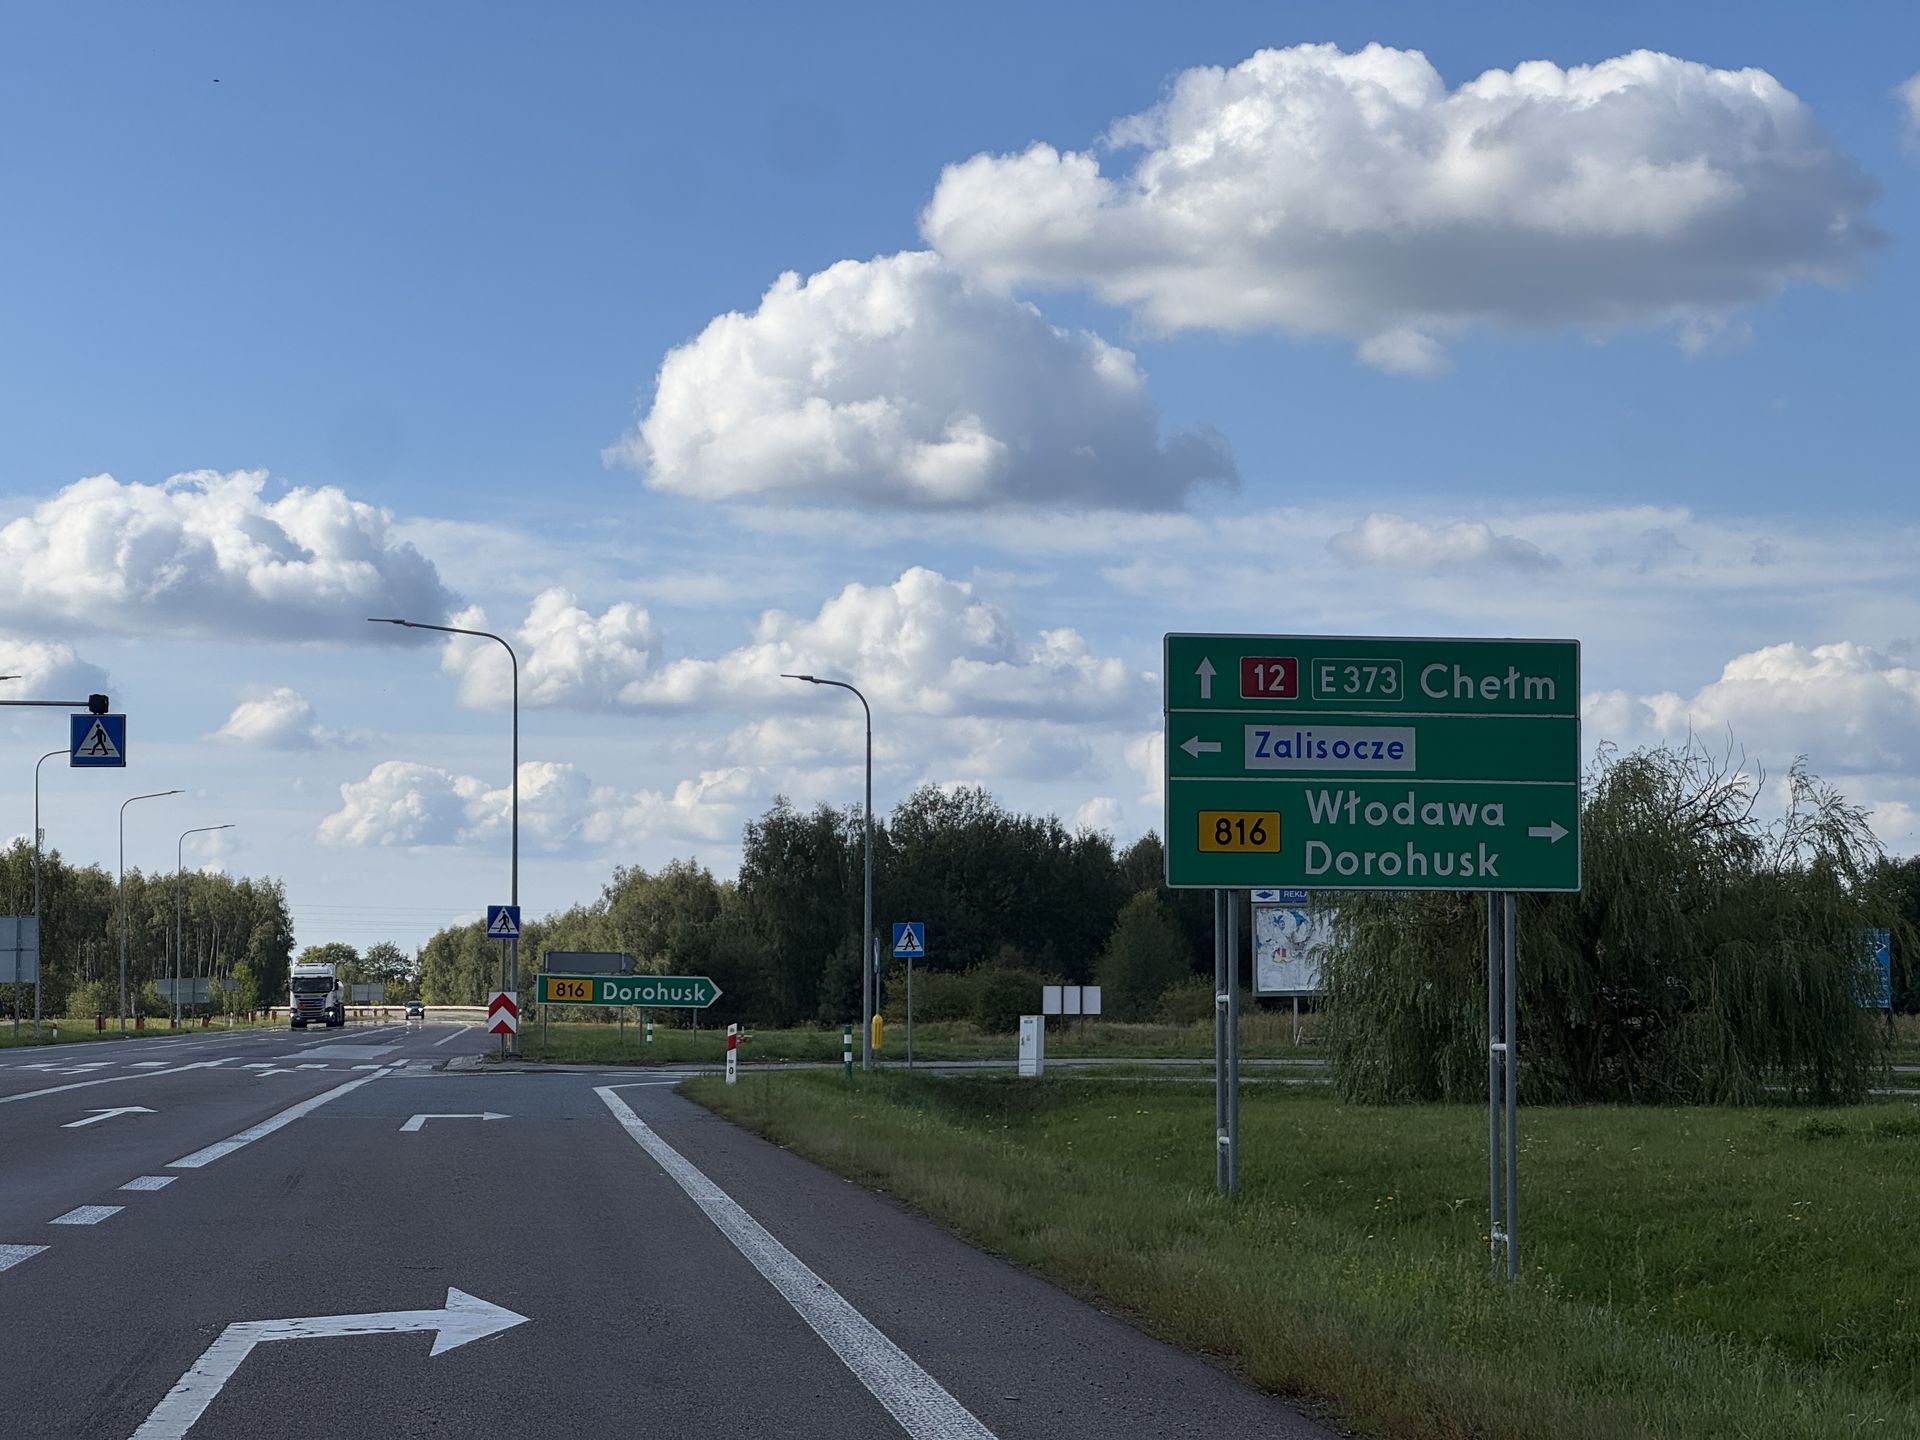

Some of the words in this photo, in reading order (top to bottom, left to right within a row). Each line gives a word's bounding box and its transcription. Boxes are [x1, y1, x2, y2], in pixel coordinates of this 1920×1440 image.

[1254, 664, 1285, 692] 12
[1321, 665, 1336, 692] E
[1343, 666, 1397, 693] 373
[1420, 663, 1555, 699] Chełm
[1254, 731, 1404, 759] Zalisocze
[1305, 789, 1505, 826] Włodawa
[1215, 818, 1267, 845] 816
[1305, 840, 1500, 876] Dorohusk
[556, 982, 585, 997] 816
[603, 982, 705, 1001] Dorohusk
